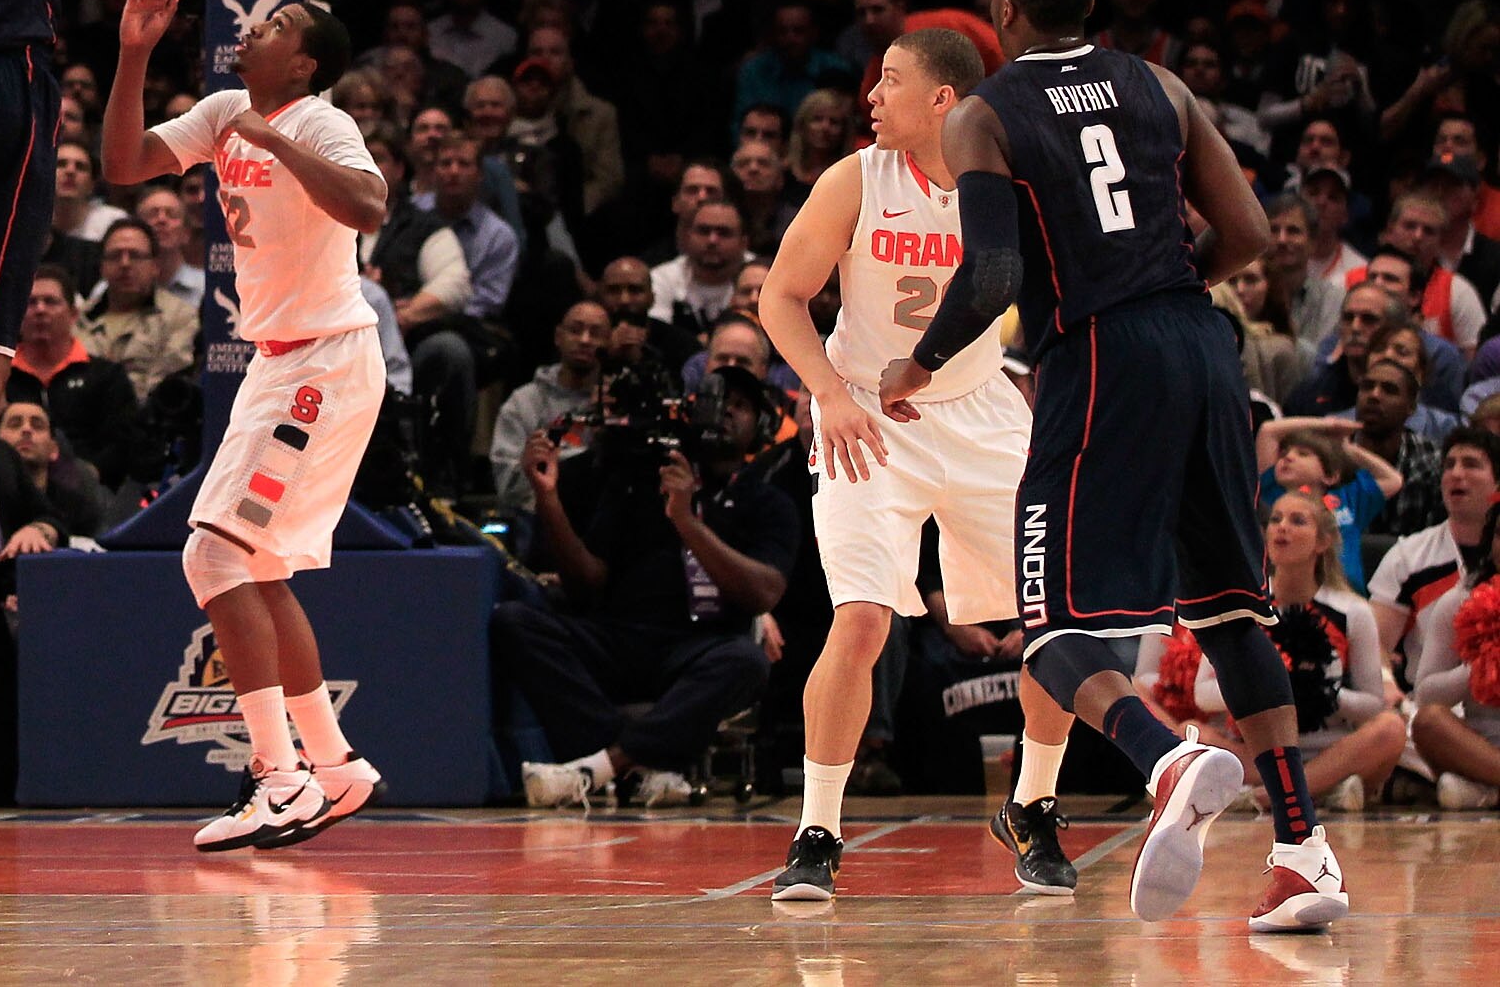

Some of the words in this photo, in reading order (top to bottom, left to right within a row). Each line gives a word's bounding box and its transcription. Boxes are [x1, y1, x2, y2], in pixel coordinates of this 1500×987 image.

[1044, 80, 1119, 115] BEVERLY
[1079, 123, 1137, 234] 2
[894, 275, 955, 331] 2
[291, 386, 322, 424] S
[1023, 502, 1050, 630] UCONN
[167, 693, 234, 715] BIG
